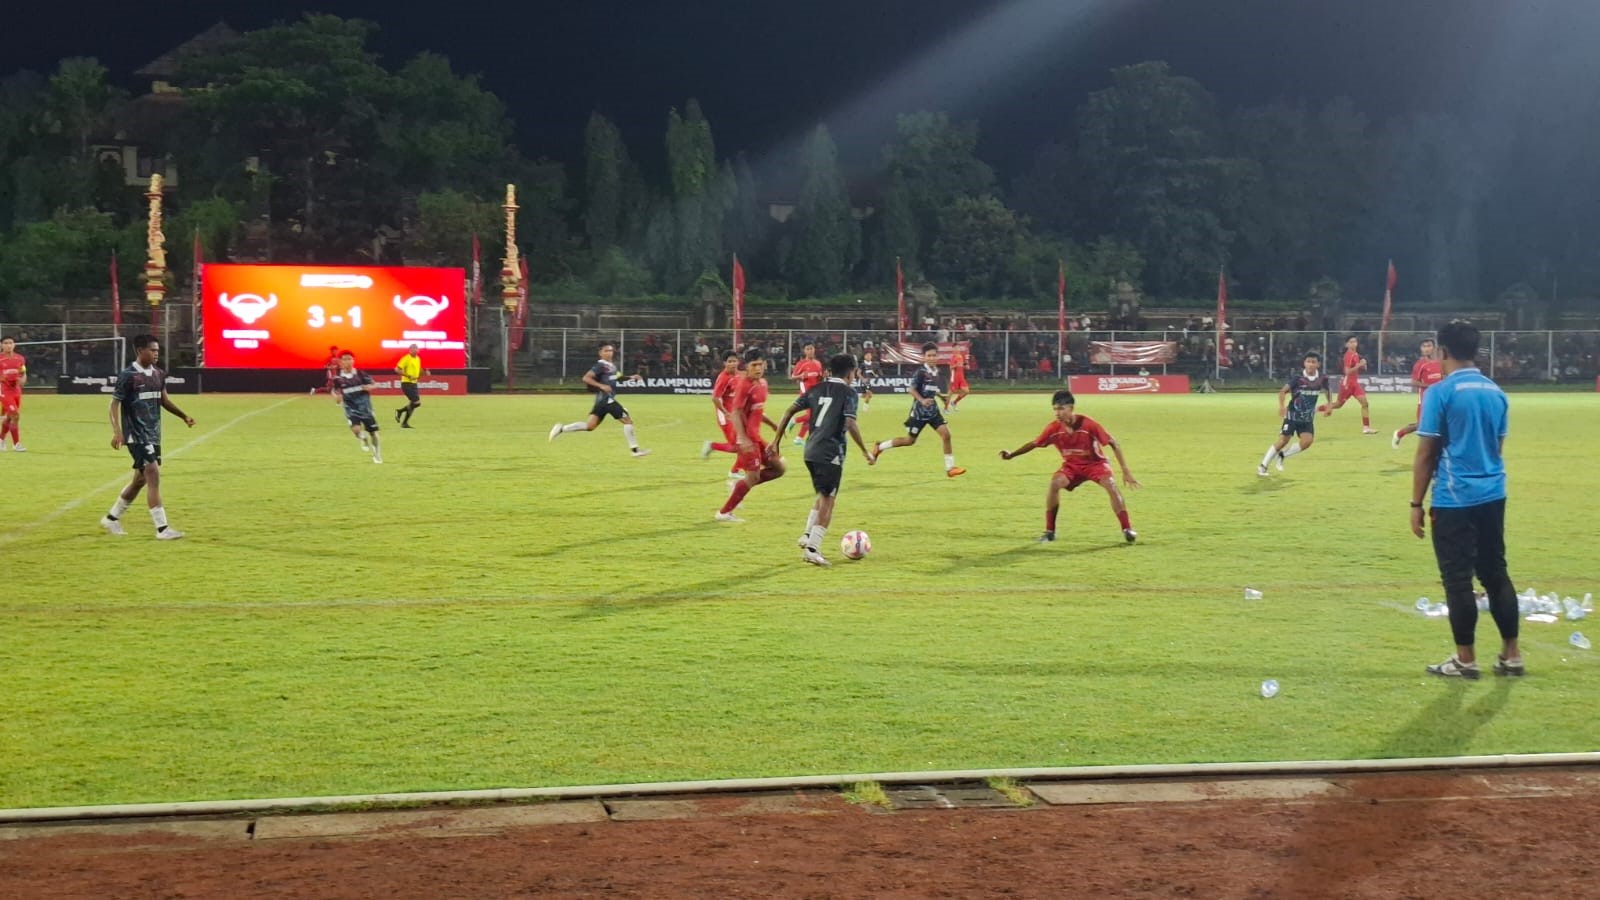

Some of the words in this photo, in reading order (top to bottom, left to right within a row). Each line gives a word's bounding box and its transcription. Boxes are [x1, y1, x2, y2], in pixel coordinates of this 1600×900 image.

[307, 305, 325, 328] 3
[347, 305, 362, 328] 1
[647, 378, 712, 387] KAMPUNG
[870, 378, 912, 386] KAMPU
[815, 397, 833, 427] 7
